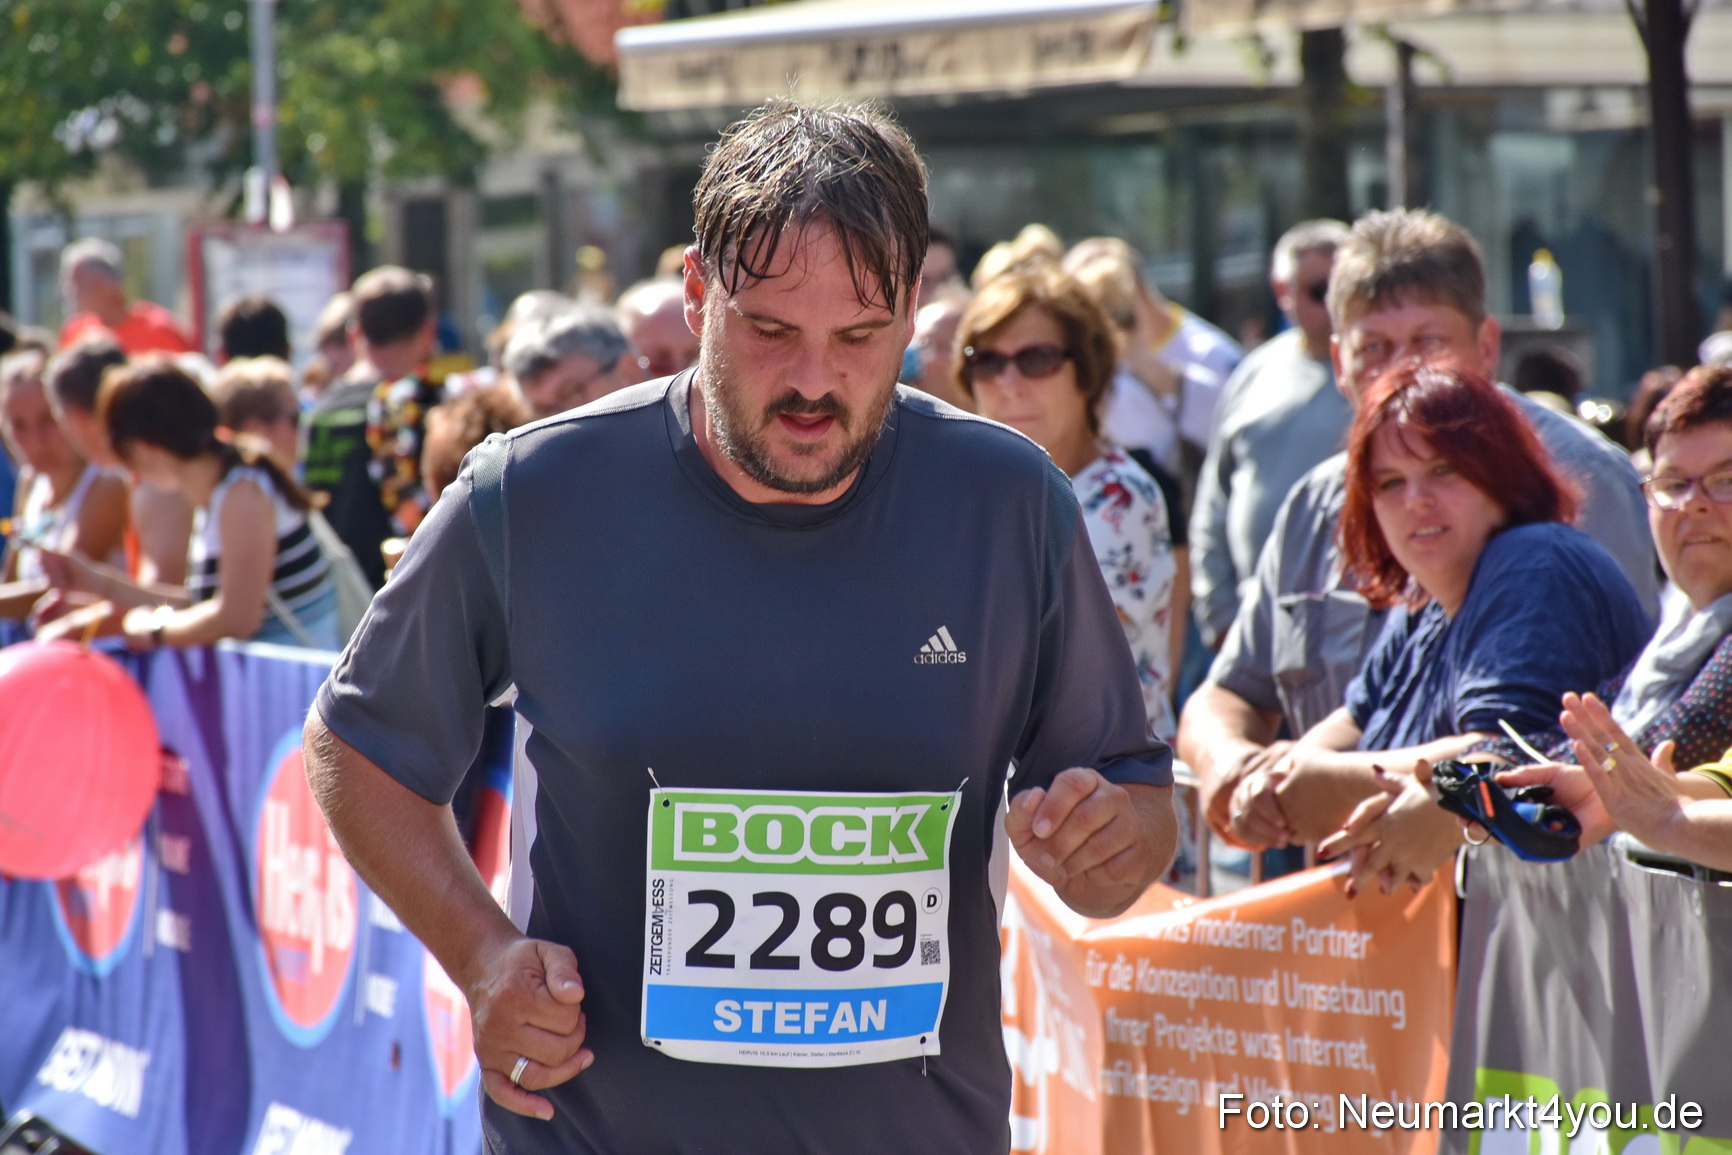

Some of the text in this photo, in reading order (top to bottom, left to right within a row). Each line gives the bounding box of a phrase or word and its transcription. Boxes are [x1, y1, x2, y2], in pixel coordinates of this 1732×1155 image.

[913, 650, 967, 665] adidas
[675, 804, 930, 864] BOCK
[926, 894, 938, 908] D
[665, 928, 673, 976] TRANSPONDER
[685, 889, 917, 972] 2289
[1191, 910, 1287, 951] moderner
[1291, 917, 1373, 960] Partner
[1084, 949, 1406, 1029] für die Konzeption und Umsetzung
[712, 999, 887, 1034] STEFAN
[1105, 1008, 1150, 1047] Ihrer
[1153, 1011, 1238, 1063] Projekte
[1241, 1030, 1283, 1062] was
